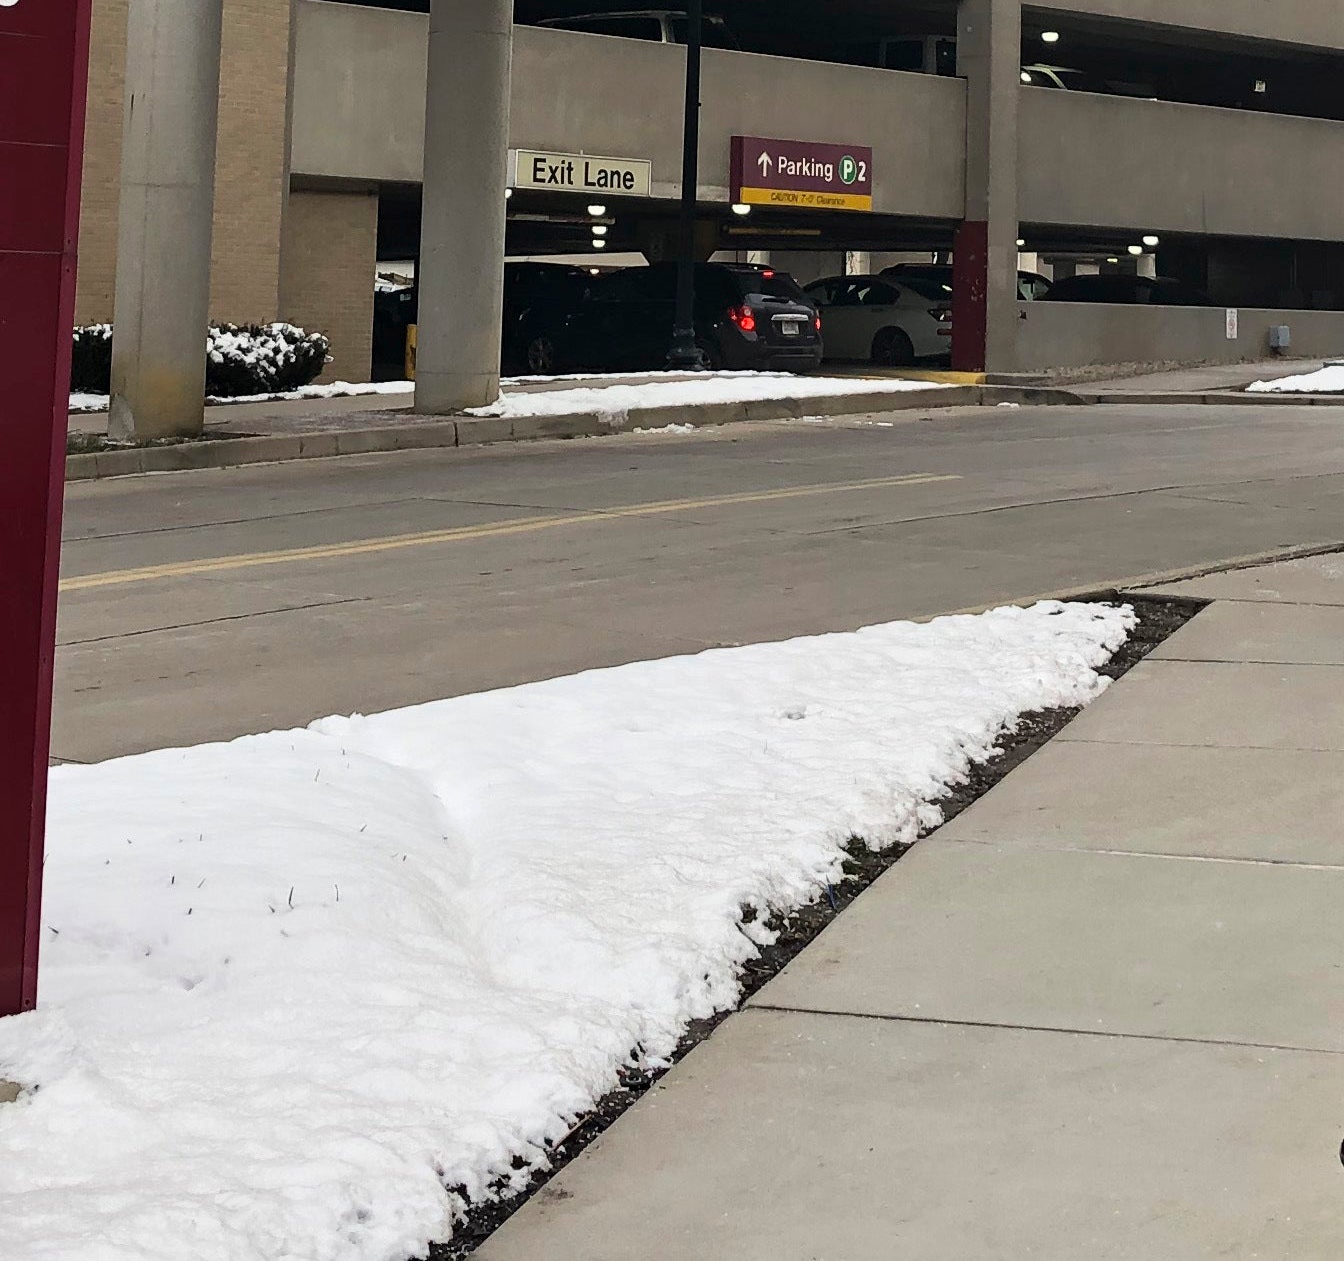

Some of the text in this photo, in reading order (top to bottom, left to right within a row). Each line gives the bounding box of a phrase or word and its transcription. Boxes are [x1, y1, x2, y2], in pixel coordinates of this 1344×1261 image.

[532, 158, 635, 190] Exit Lane
[778, 156, 866, 182] Parking P 2
